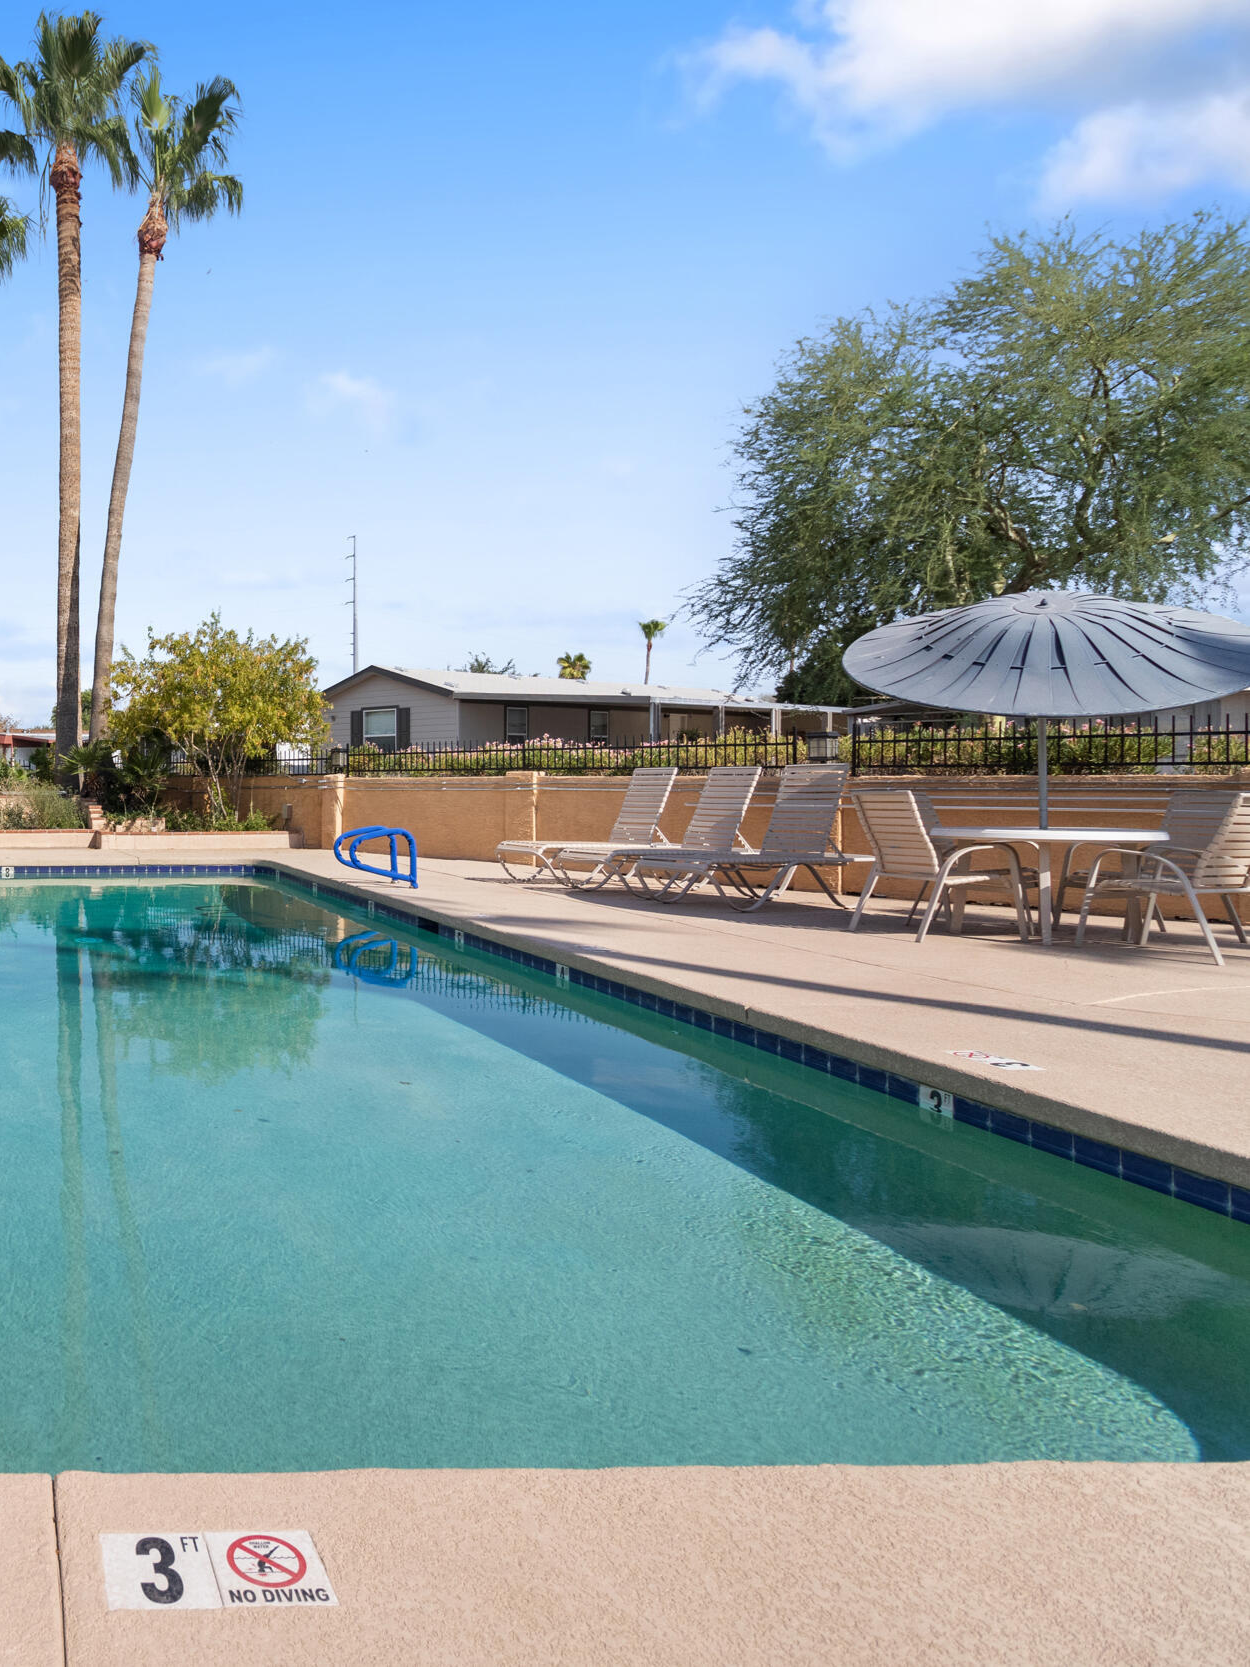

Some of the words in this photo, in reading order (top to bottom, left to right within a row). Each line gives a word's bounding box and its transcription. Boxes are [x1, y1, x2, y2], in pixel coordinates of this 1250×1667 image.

[135, 1537, 184, 1604] 3
[180, 1536, 199, 1552] FT
[229, 1590, 256, 1604] NO
[262, 1588, 331, 1603] DIVING
